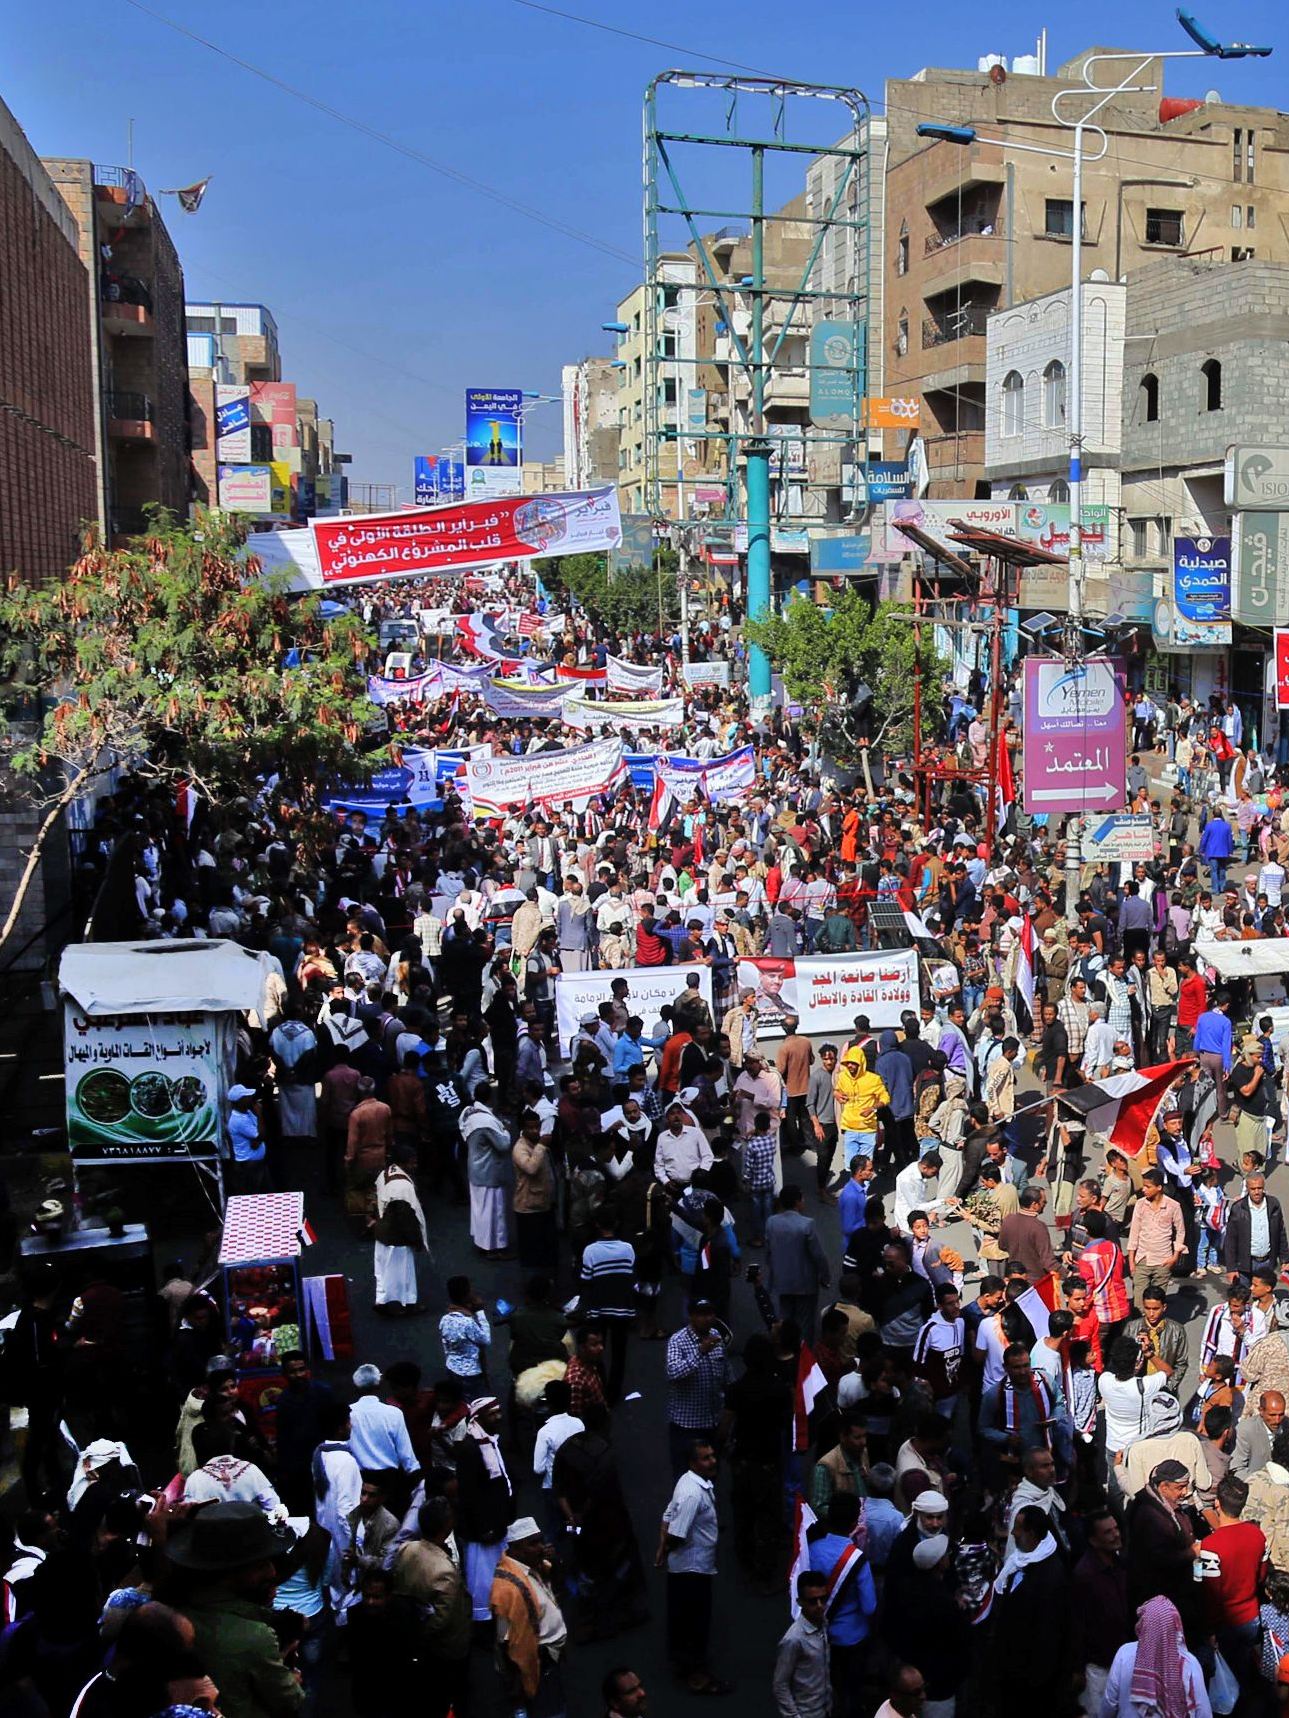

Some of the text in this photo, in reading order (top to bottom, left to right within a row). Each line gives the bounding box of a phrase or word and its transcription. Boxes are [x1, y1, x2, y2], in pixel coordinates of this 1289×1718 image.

[868, 471, 910, 484] السلامة
[966, 507, 1010, 521] الأوروبي
[350, 525, 390, 547] الأولى
[393, 523, 445, 539] الطلقة
[328, 532, 347, 553] في
[401, 538, 467, 560] المشروع
[470, 534, 501, 550] قلب
[1179, 555, 1227, 571] صيدلية
[1180, 573, 1227, 591] الحمدي
[1062, 686, 1106, 700] Yemen
[1046, 746, 1110, 773] المعتمد
[812, 962, 910, 988] أرضنا صانعة المجد
[641, 988, 669, 1000] مكان
[670, 988, 676, 997] لا
[851, 989, 878, 1003] القادة
[881, 987, 911, 1003] وولادة
